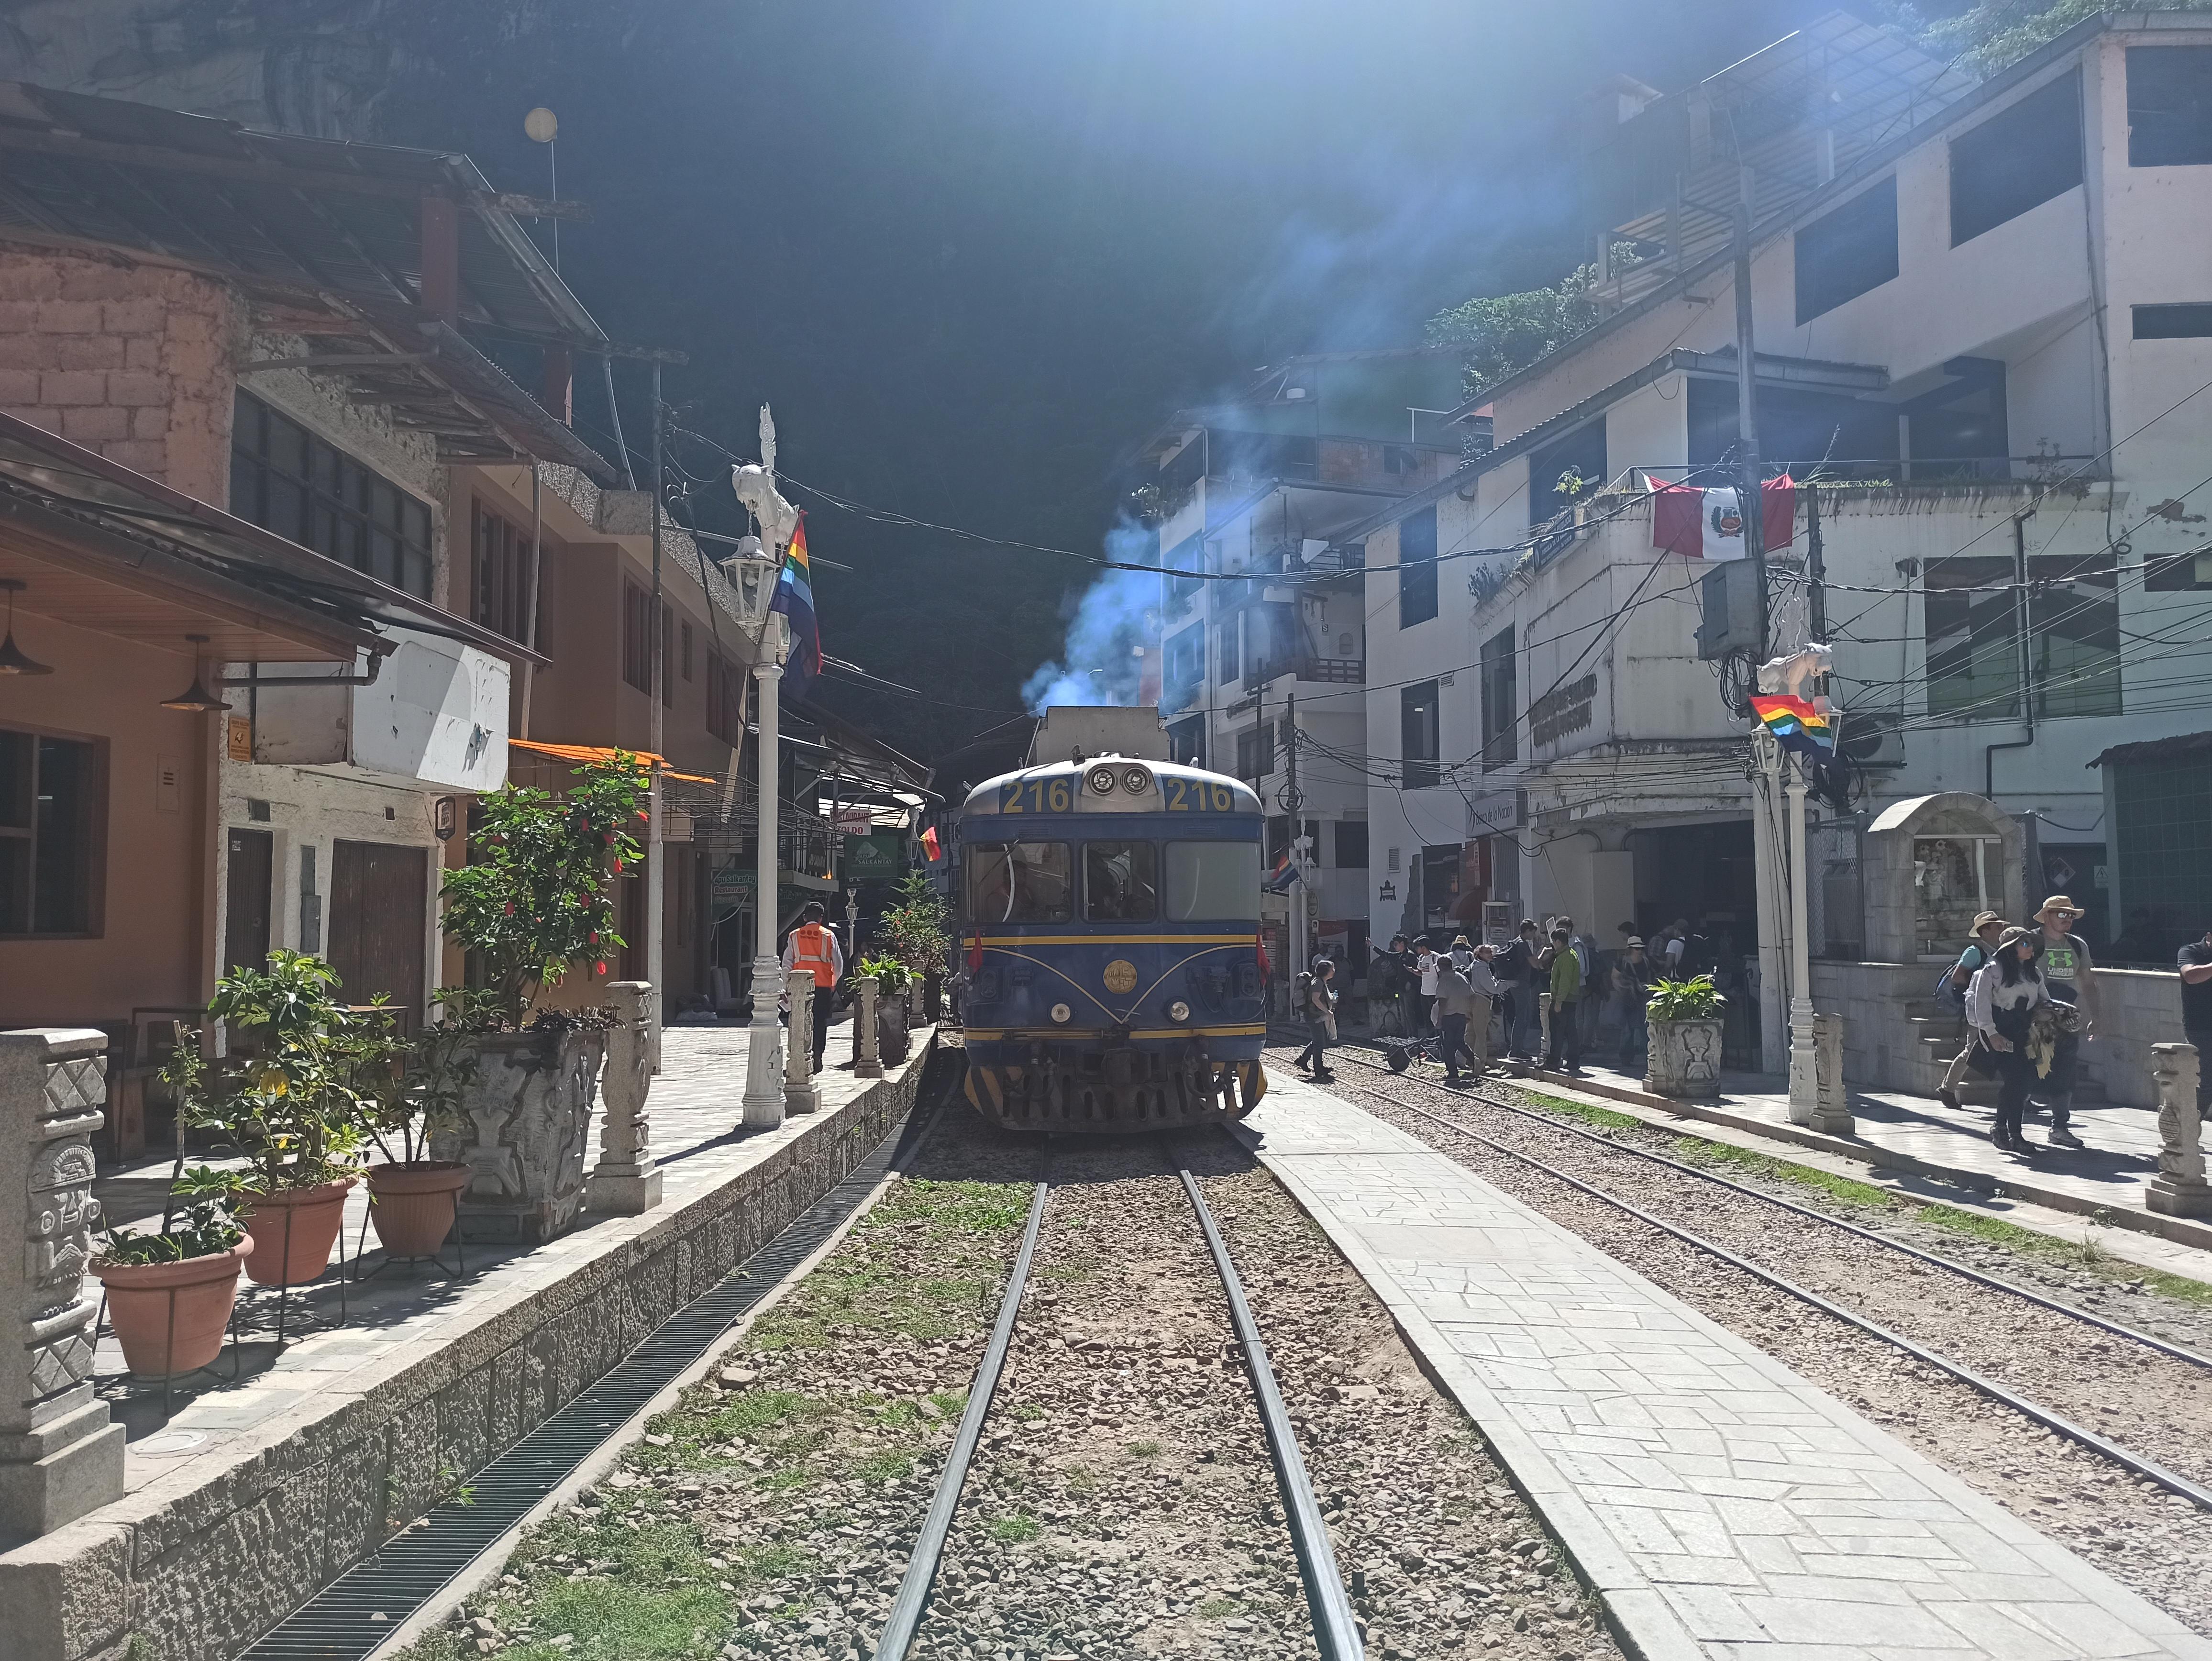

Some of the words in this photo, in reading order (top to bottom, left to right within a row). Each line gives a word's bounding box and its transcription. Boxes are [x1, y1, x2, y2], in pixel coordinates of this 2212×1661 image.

[1003, 779, 1069, 813] 216
[1168, 778, 1231, 812] 216
[1488, 807, 1492, 822] de
[1493, 806, 1497, 821] la
[715, 876, 726, 886] Apu
[726, 874, 756, 885] Salkantay
[714, 886, 748, 895] Restaurant
